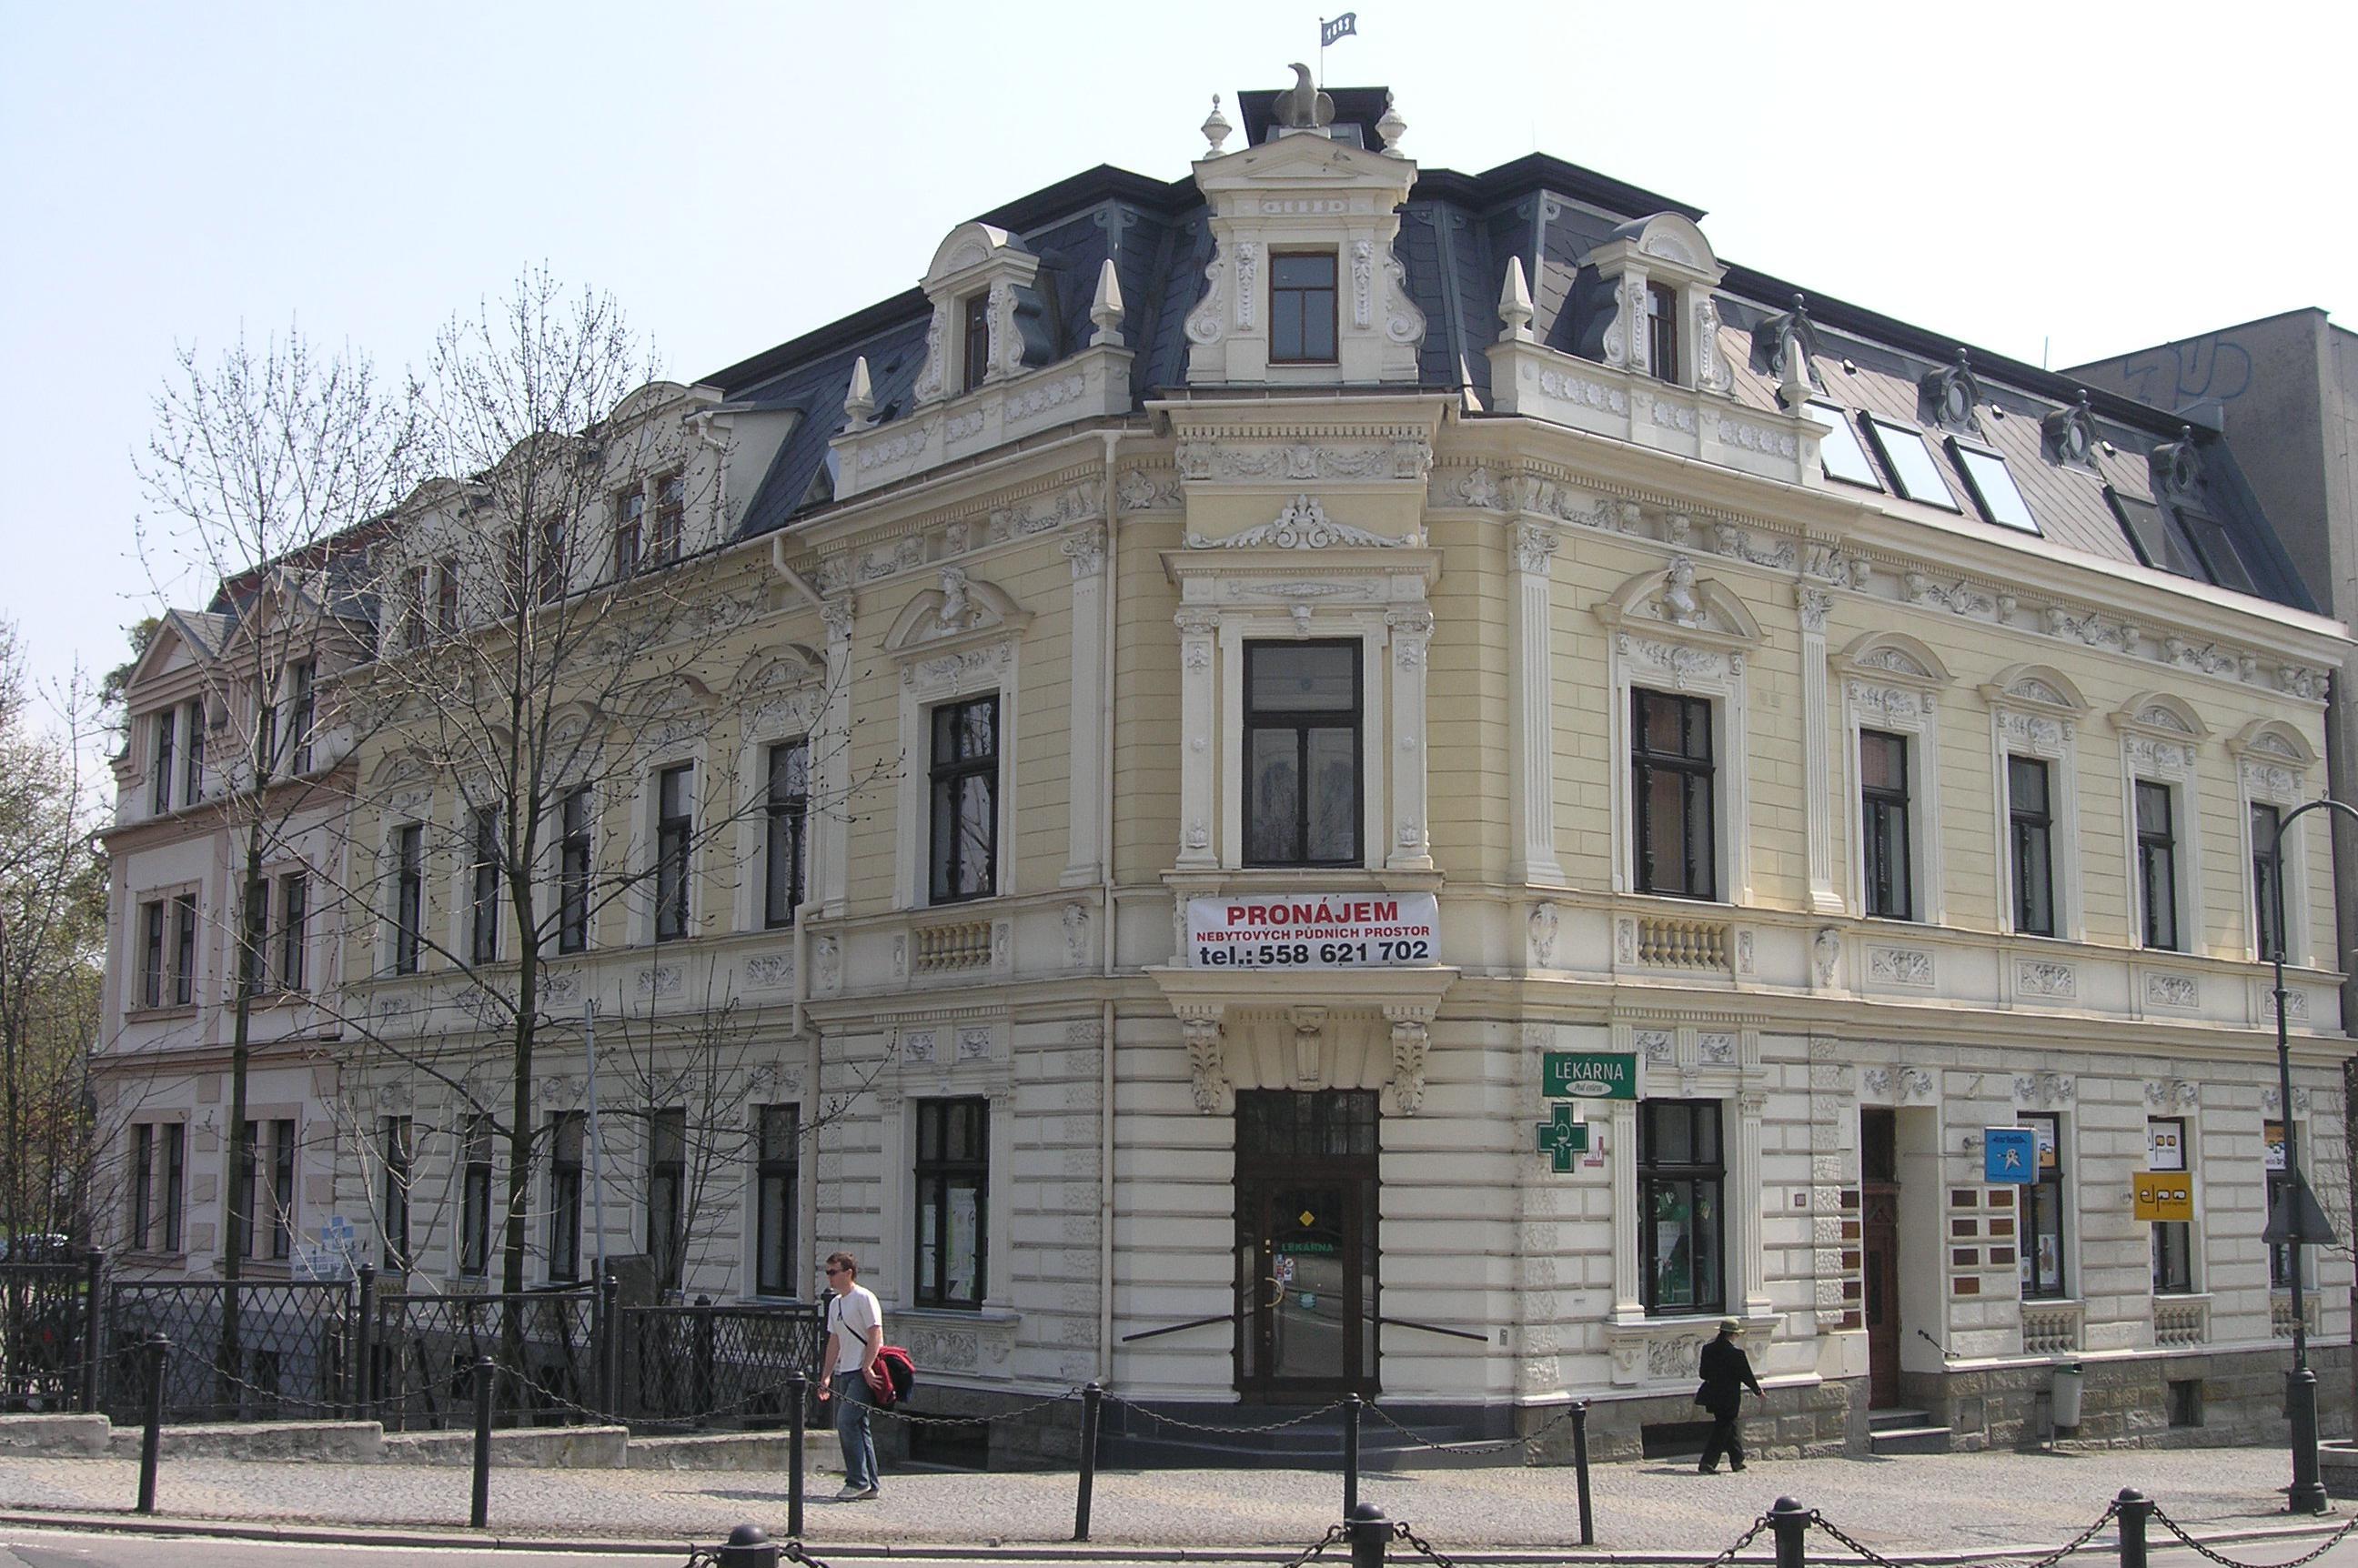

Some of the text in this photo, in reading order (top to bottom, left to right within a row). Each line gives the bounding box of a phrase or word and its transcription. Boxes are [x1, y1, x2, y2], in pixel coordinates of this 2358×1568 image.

[1227, 897, 1398, 926] PRONÁJEM
[1196, 926, 1430, 942] NEBYTOVÝCH PŮDNÍCH PROSTOR
[1200, 940, 1429, 965] tel.: 558 621 702
[1555, 1057, 1624, 1081] LÉKÁRNA
